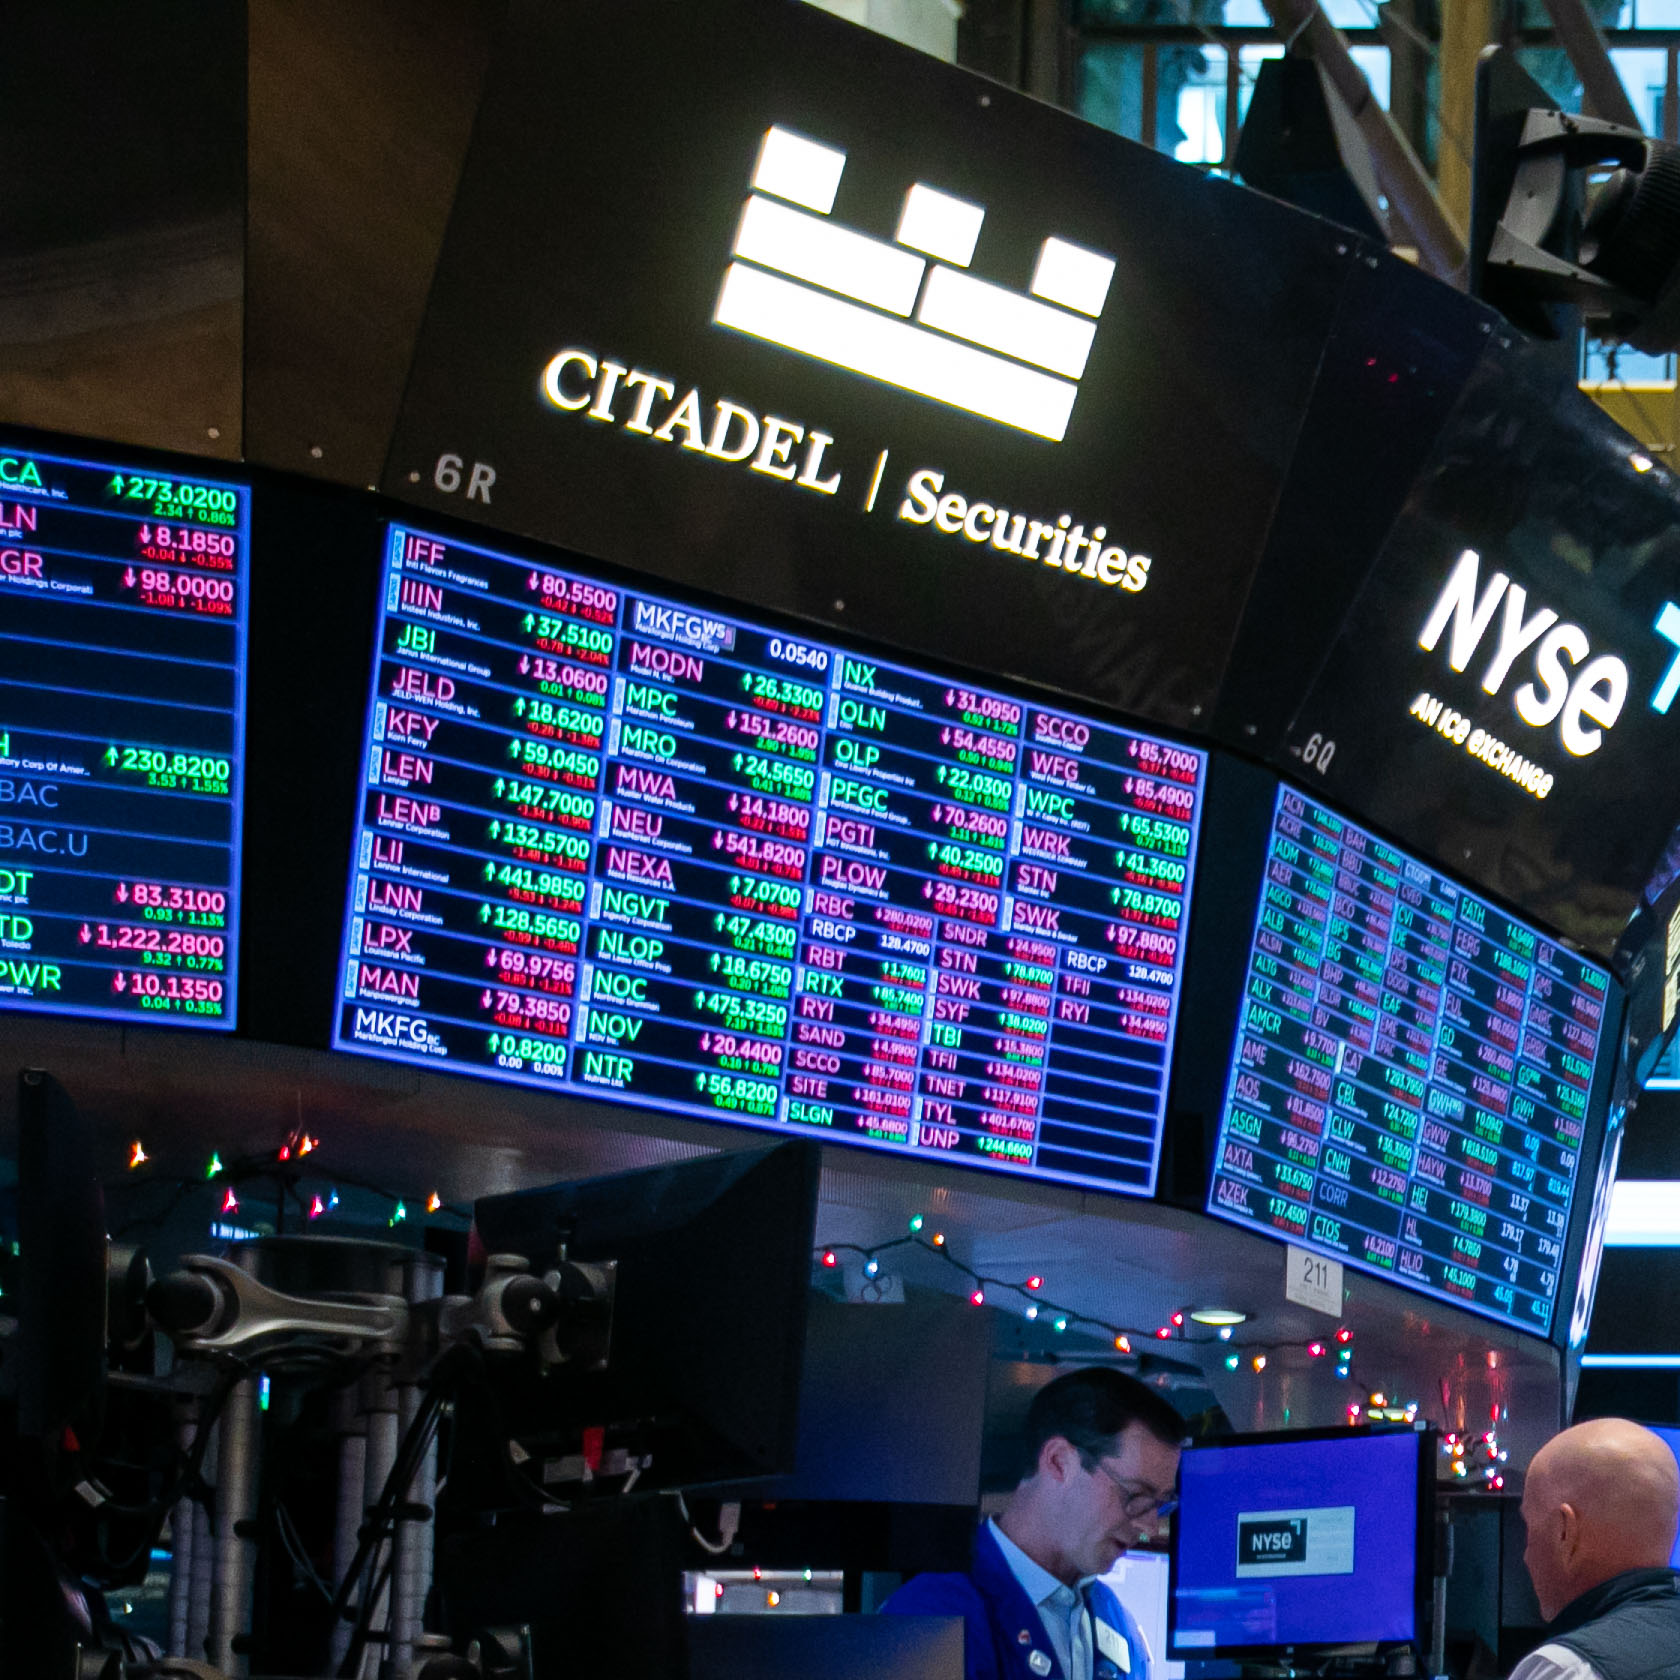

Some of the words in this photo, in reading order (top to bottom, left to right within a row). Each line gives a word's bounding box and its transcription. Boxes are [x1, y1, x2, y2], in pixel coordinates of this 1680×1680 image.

[541, 347, 842, 496] CITADEL
[898, 469, 1154, 594] Securities
[127, 475, 237, 513] 273.0200
[153, 502, 184, 519] 2.34
[155, 525, 236, 557] 8.1850
[404, 534, 447, 567] IFF
[140, 569, 235, 603] 98.0000
[541, 574, 618, 613] 80.5500
[397, 622, 437, 655] JBI
[537, 615, 613, 655] 37.5100
[630, 641, 706, 684] MODN
[769, 638, 829, 672] 0.0540
[392, 665, 457, 703] JELD
[626, 682, 679, 718] MPC
[387, 706, 441, 742] KFY
[1410, 691, 1437, 728] AN
[121, 747, 231, 782] 230.8200
[524, 740, 600, 780] 59.0450
[1302, 731, 1337, 776] 6Q
[1027, 787, 1077, 822] WPC
[608, 847, 675, 883] NEXA
[821, 854, 889, 891] PLOW
[132, 882, 226, 915] 83.3100
[96, 923, 225, 959] 1,222.2800
[499, 949, 577, 984] 69.9756
[1066, 950, 1108, 975] RBCP
[130, 972, 224, 1004] 10.1350
[359, 963, 421, 999] MAN
[706, 992, 788, 1027] 475.3250
[1249, 1004, 1283, 1036] AMCR
[584, 1050, 635, 1083] NTR
[707, 1074, 779, 1103] 56.8200
[788, 1106, 834, 1127] SLGN
[1230, 1111, 1263, 1139] ASGN
[919, 1126, 961, 1150] UNP
[1312, 1213, 1342, 1241] CTOS
[1302, 1256, 1330, 1290] 211
